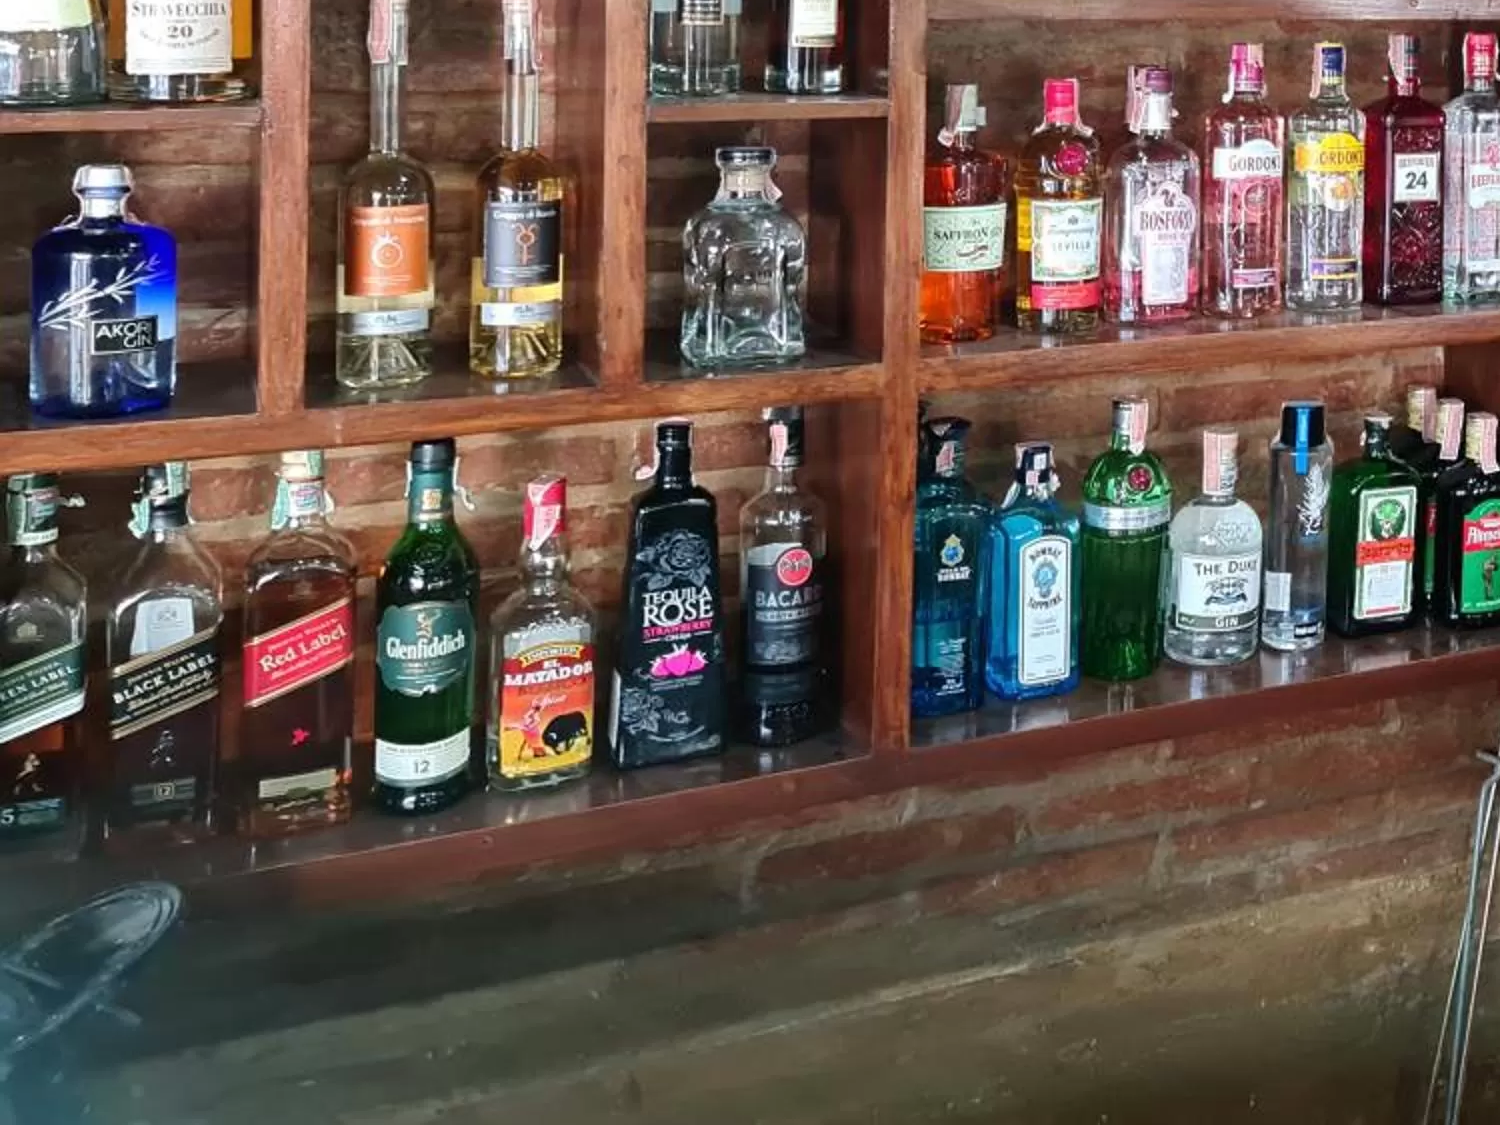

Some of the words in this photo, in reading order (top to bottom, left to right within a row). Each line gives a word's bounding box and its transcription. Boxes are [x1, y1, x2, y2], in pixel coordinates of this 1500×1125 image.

[167, 26, 194, 40] 20
[1405, 170, 1428, 190] 24
[933, 226, 990, 242] SAFFRON
[123, 335, 152, 348] GIN
[1193, 561, 1223, 576] THE
[642, 586, 713, 607] TEQUILA
[643, 598, 715, 627] ROSE
[1215, 615, 1240, 628] GIN
[259, 648, 296, 672] Red
[299, 624, 348, 657] Label
[386, 629, 466, 661] Glenfiddich
[113, 673, 166, 704] BLACK
[168, 653, 217, 681] LABEL
[504, 660, 594, 686] MATADOR
[413, 760, 431, 775] 12
